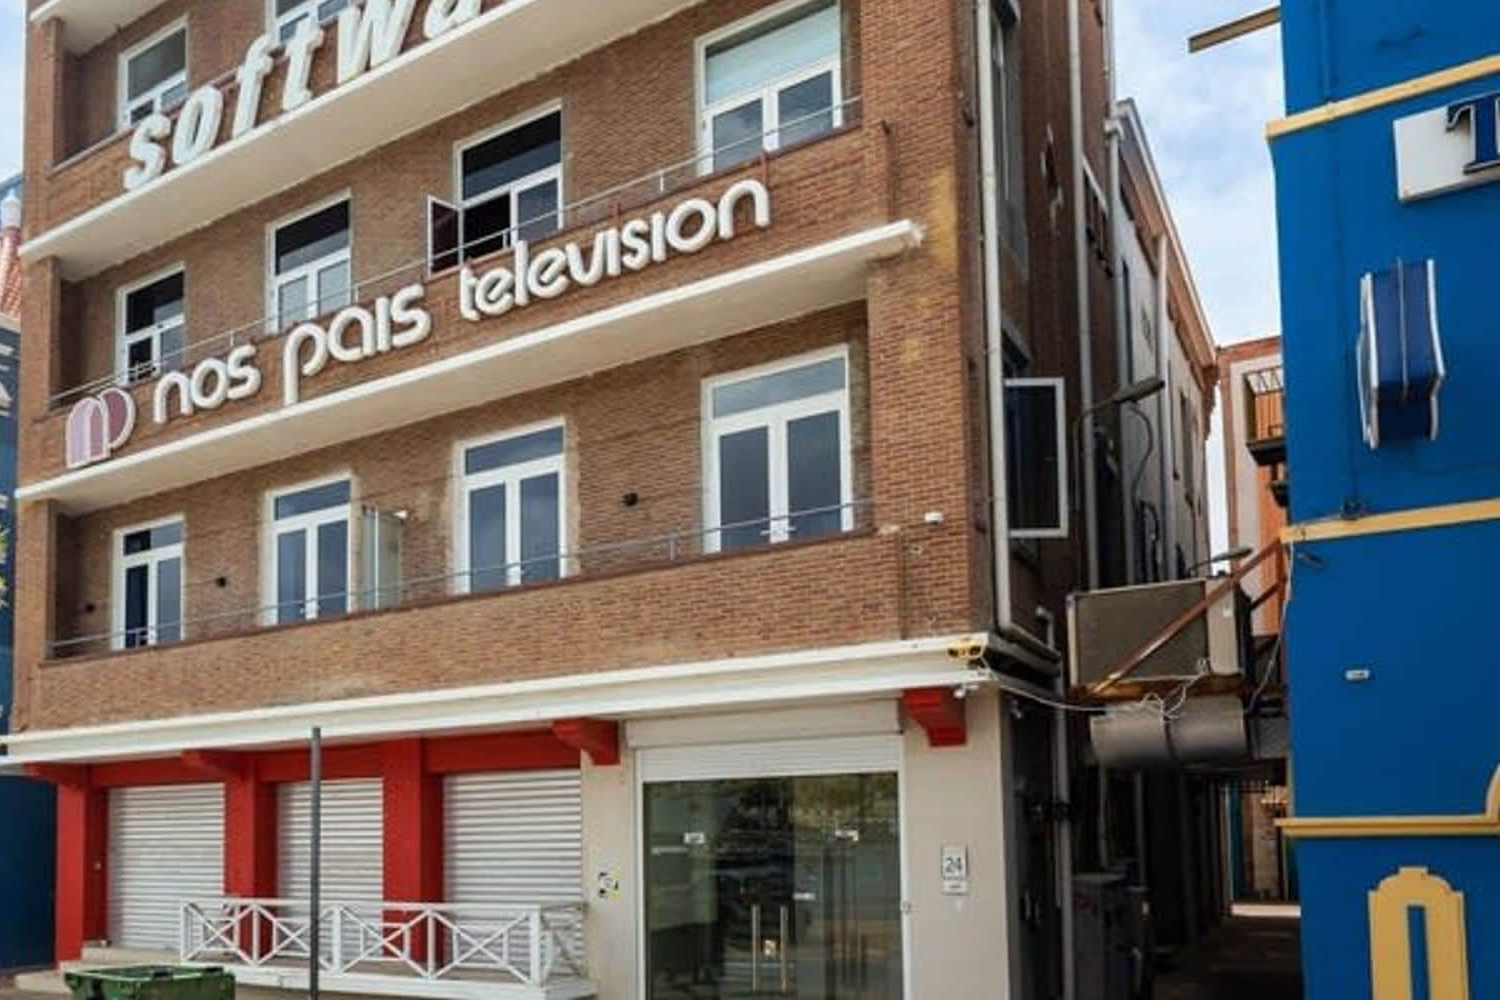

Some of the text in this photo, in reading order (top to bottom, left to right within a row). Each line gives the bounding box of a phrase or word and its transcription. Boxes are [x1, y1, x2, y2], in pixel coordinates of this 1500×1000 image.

[153, 178, 771, 425] nos pais television
[945, 856, 963, 873] 24
